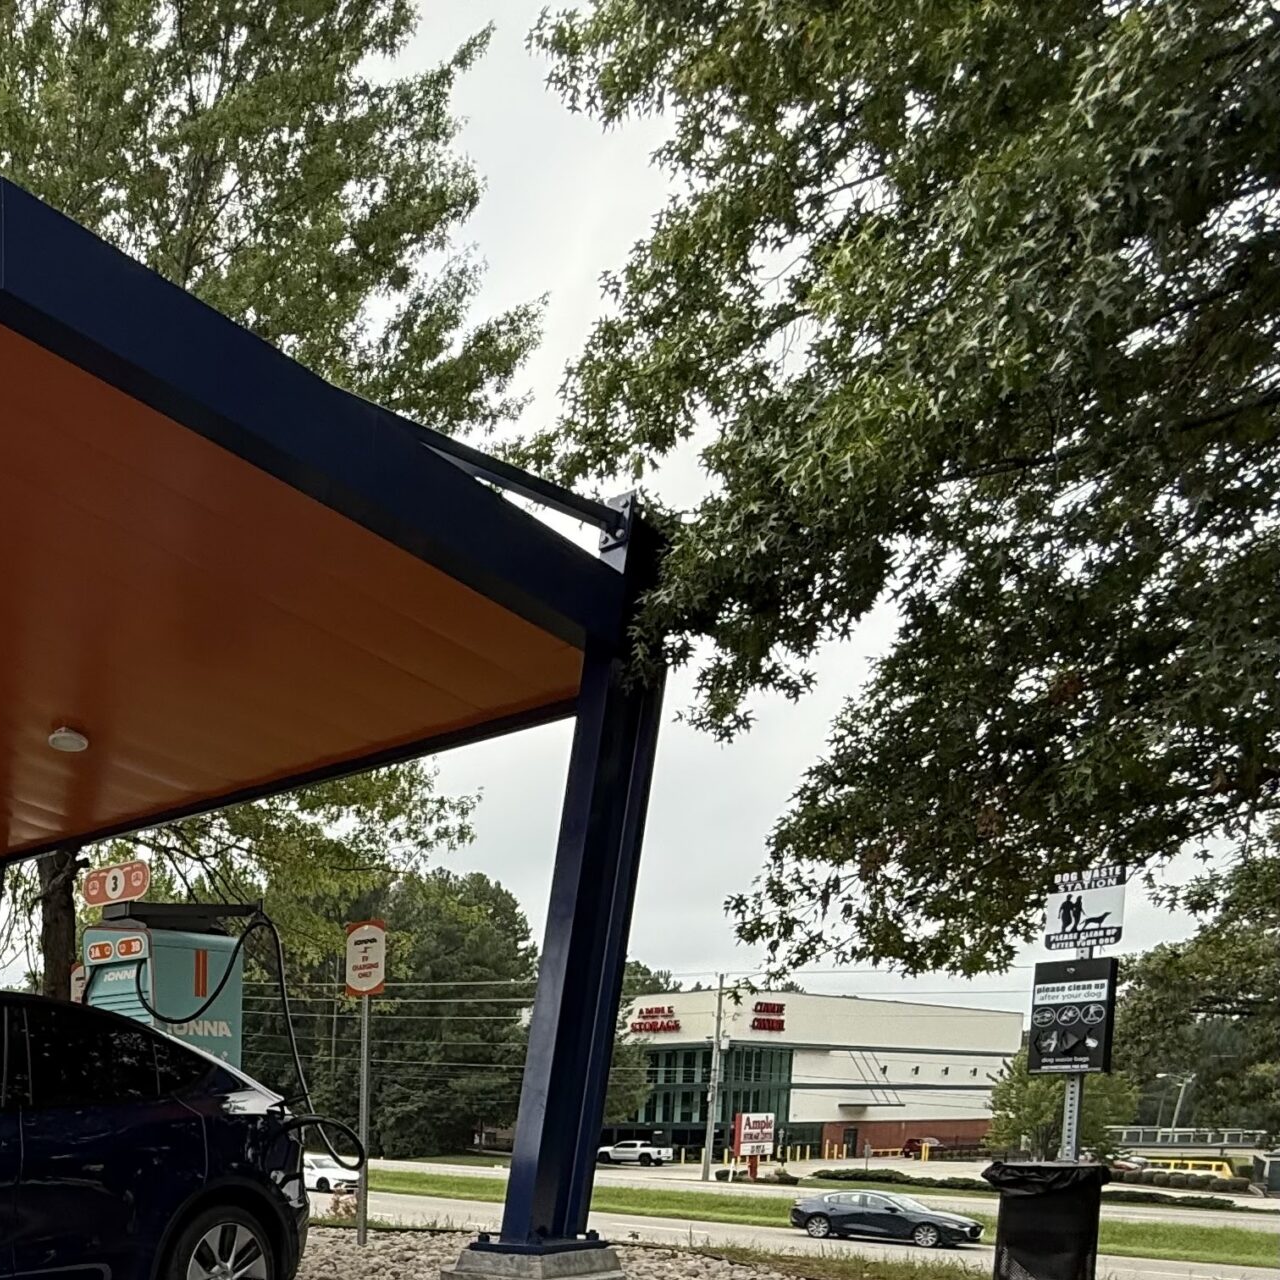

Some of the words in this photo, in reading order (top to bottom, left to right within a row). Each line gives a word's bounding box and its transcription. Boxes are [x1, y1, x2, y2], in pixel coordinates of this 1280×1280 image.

[1054, 872, 1078, 884] DOG
[1081, 865, 1121, 882] WASTE
[111, 875, 119, 892] 3
[1057, 877, 1117, 893] STATION
[1050, 932, 1078, 942] PLEASE
[1080, 929, 1104, 940] CLEAN
[1105, 928, 1118, 936] UP
[1051, 941, 1074, 950] AFTER
[1076, 938, 1097, 947] YOUR
[1036, 984, 1066, 994] please
[1067, 983, 1093, 991] clean
[1094, 982, 1106, 990] up
[1061, 992, 1082, 1000] your
[1083, 990, 1102, 998] dog
[630, 1019, 681, 1033] STORAGE
[743, 1115, 773, 1133] Ample
